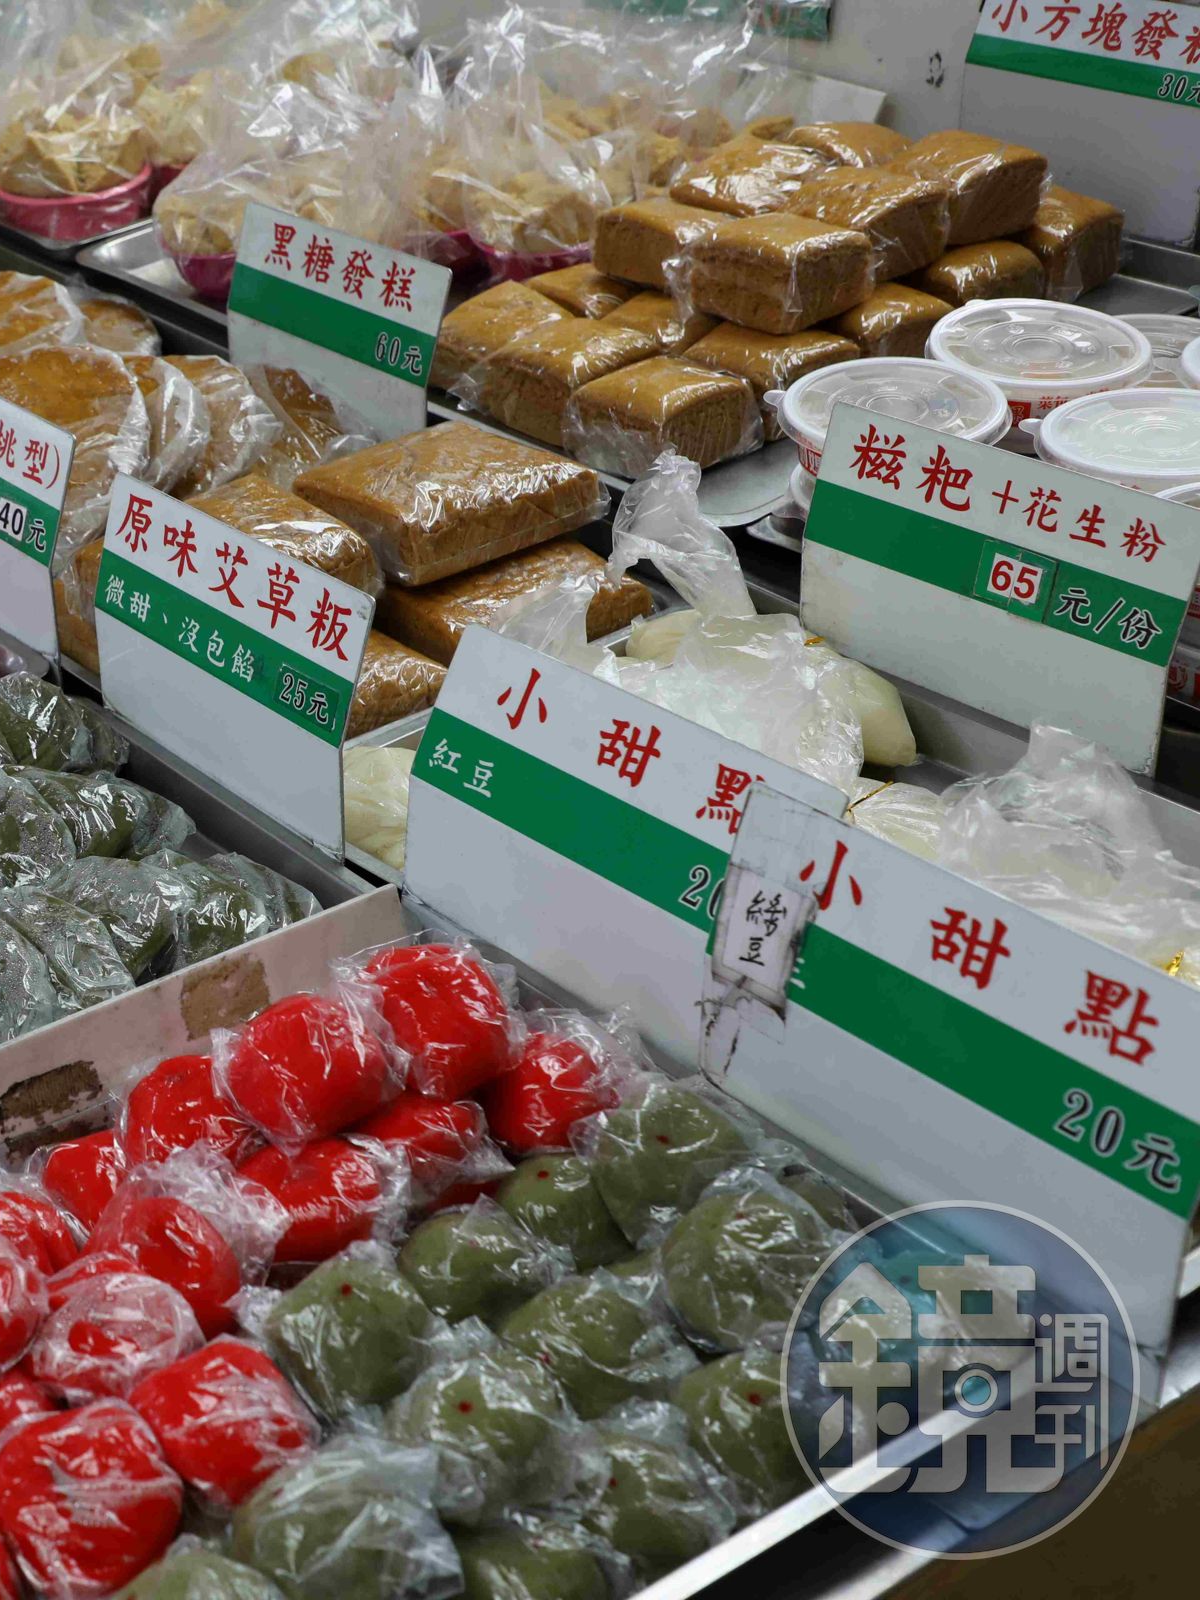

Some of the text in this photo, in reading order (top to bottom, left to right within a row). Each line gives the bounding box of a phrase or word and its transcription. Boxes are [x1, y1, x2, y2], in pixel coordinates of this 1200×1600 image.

[263, 221, 417, 313] 黑糖發糕
[375, 331, 423, 377] 60元
[278, 672, 330, 725] 25元
[427, 737, 495, 799] 紅豆
[799, 839, 1160, 1067] 小甜點
[1052, 1087, 1183, 1195] 20元
